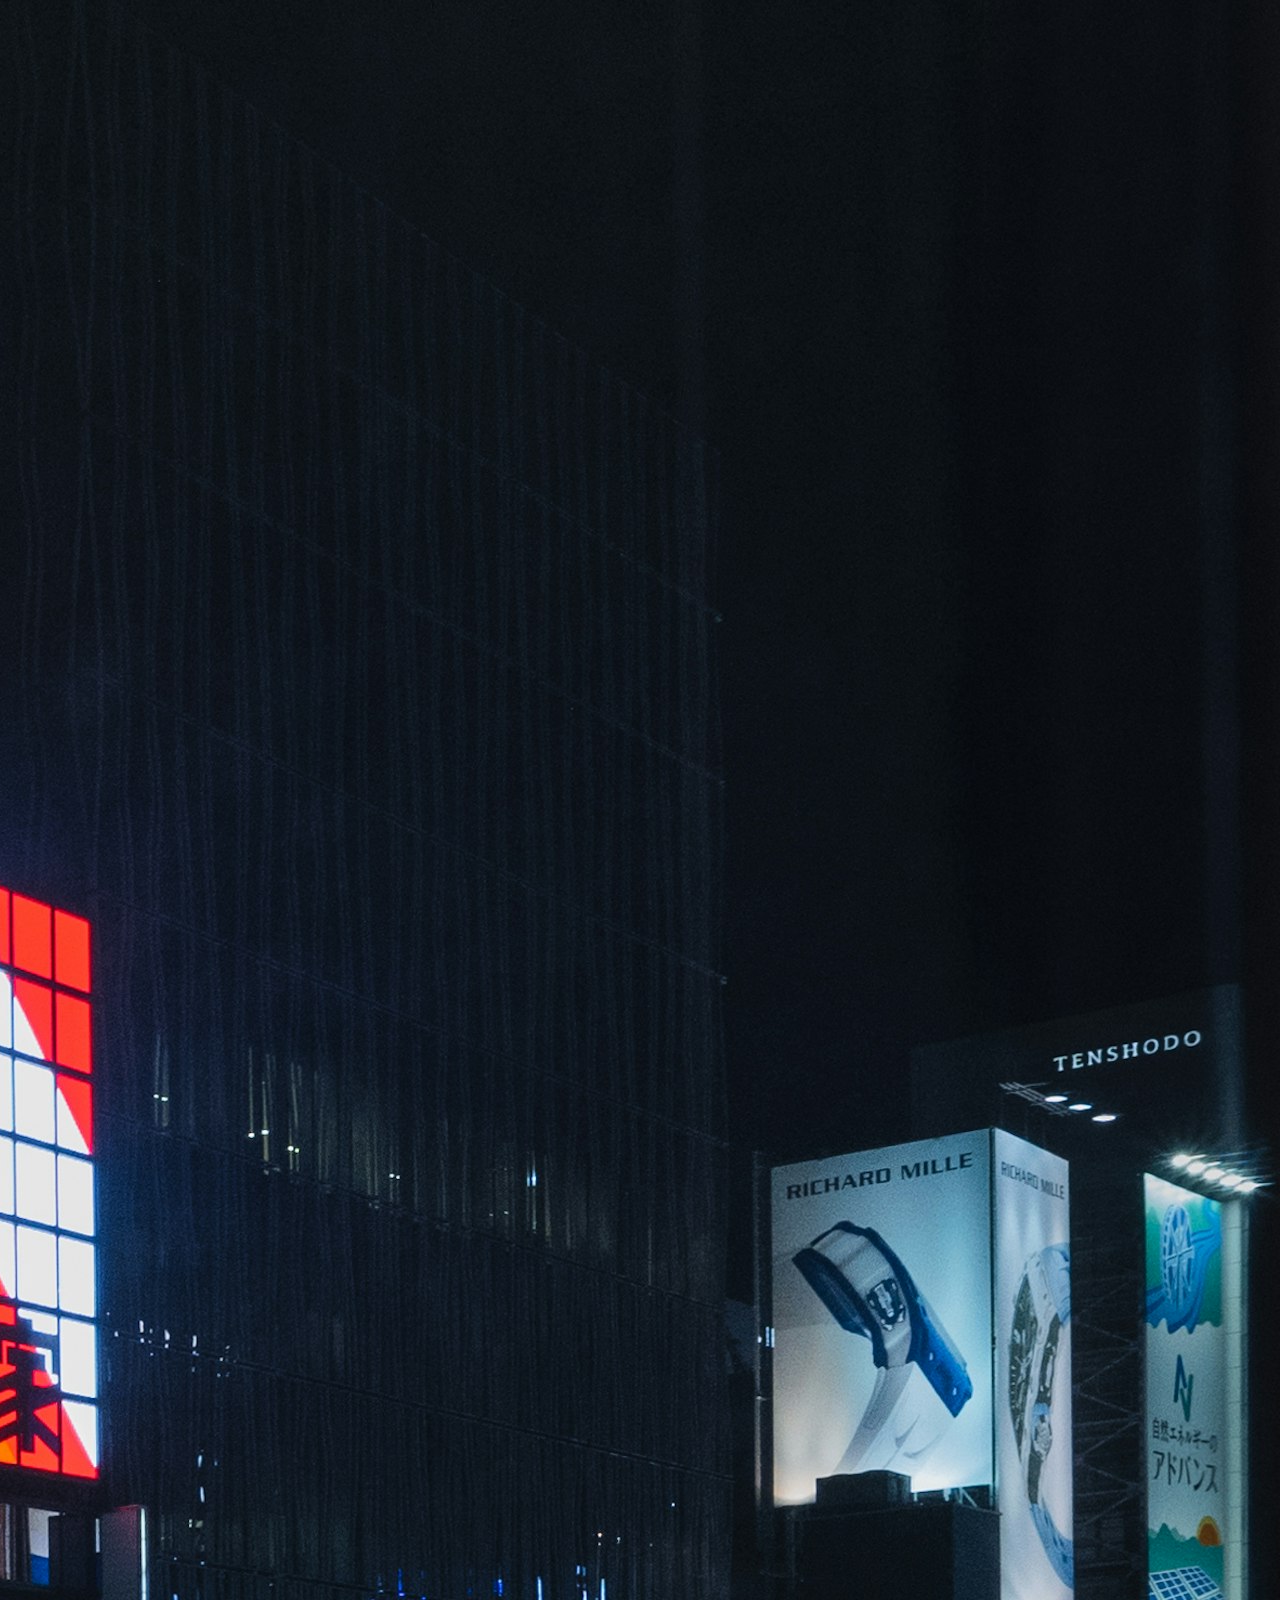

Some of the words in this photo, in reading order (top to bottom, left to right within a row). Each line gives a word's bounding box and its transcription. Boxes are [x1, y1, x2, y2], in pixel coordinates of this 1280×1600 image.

[1053, 1030, 1203, 1073] TENSHODO
[786, 1165, 893, 1201] RICHARD
[900, 1151, 974, 1178] MILLE
[1000, 1160, 1038, 1190] RICHARD
[1041, 1175, 1066, 1202] MILLE
[1152, 1448, 1220, 1494] アドバンス
